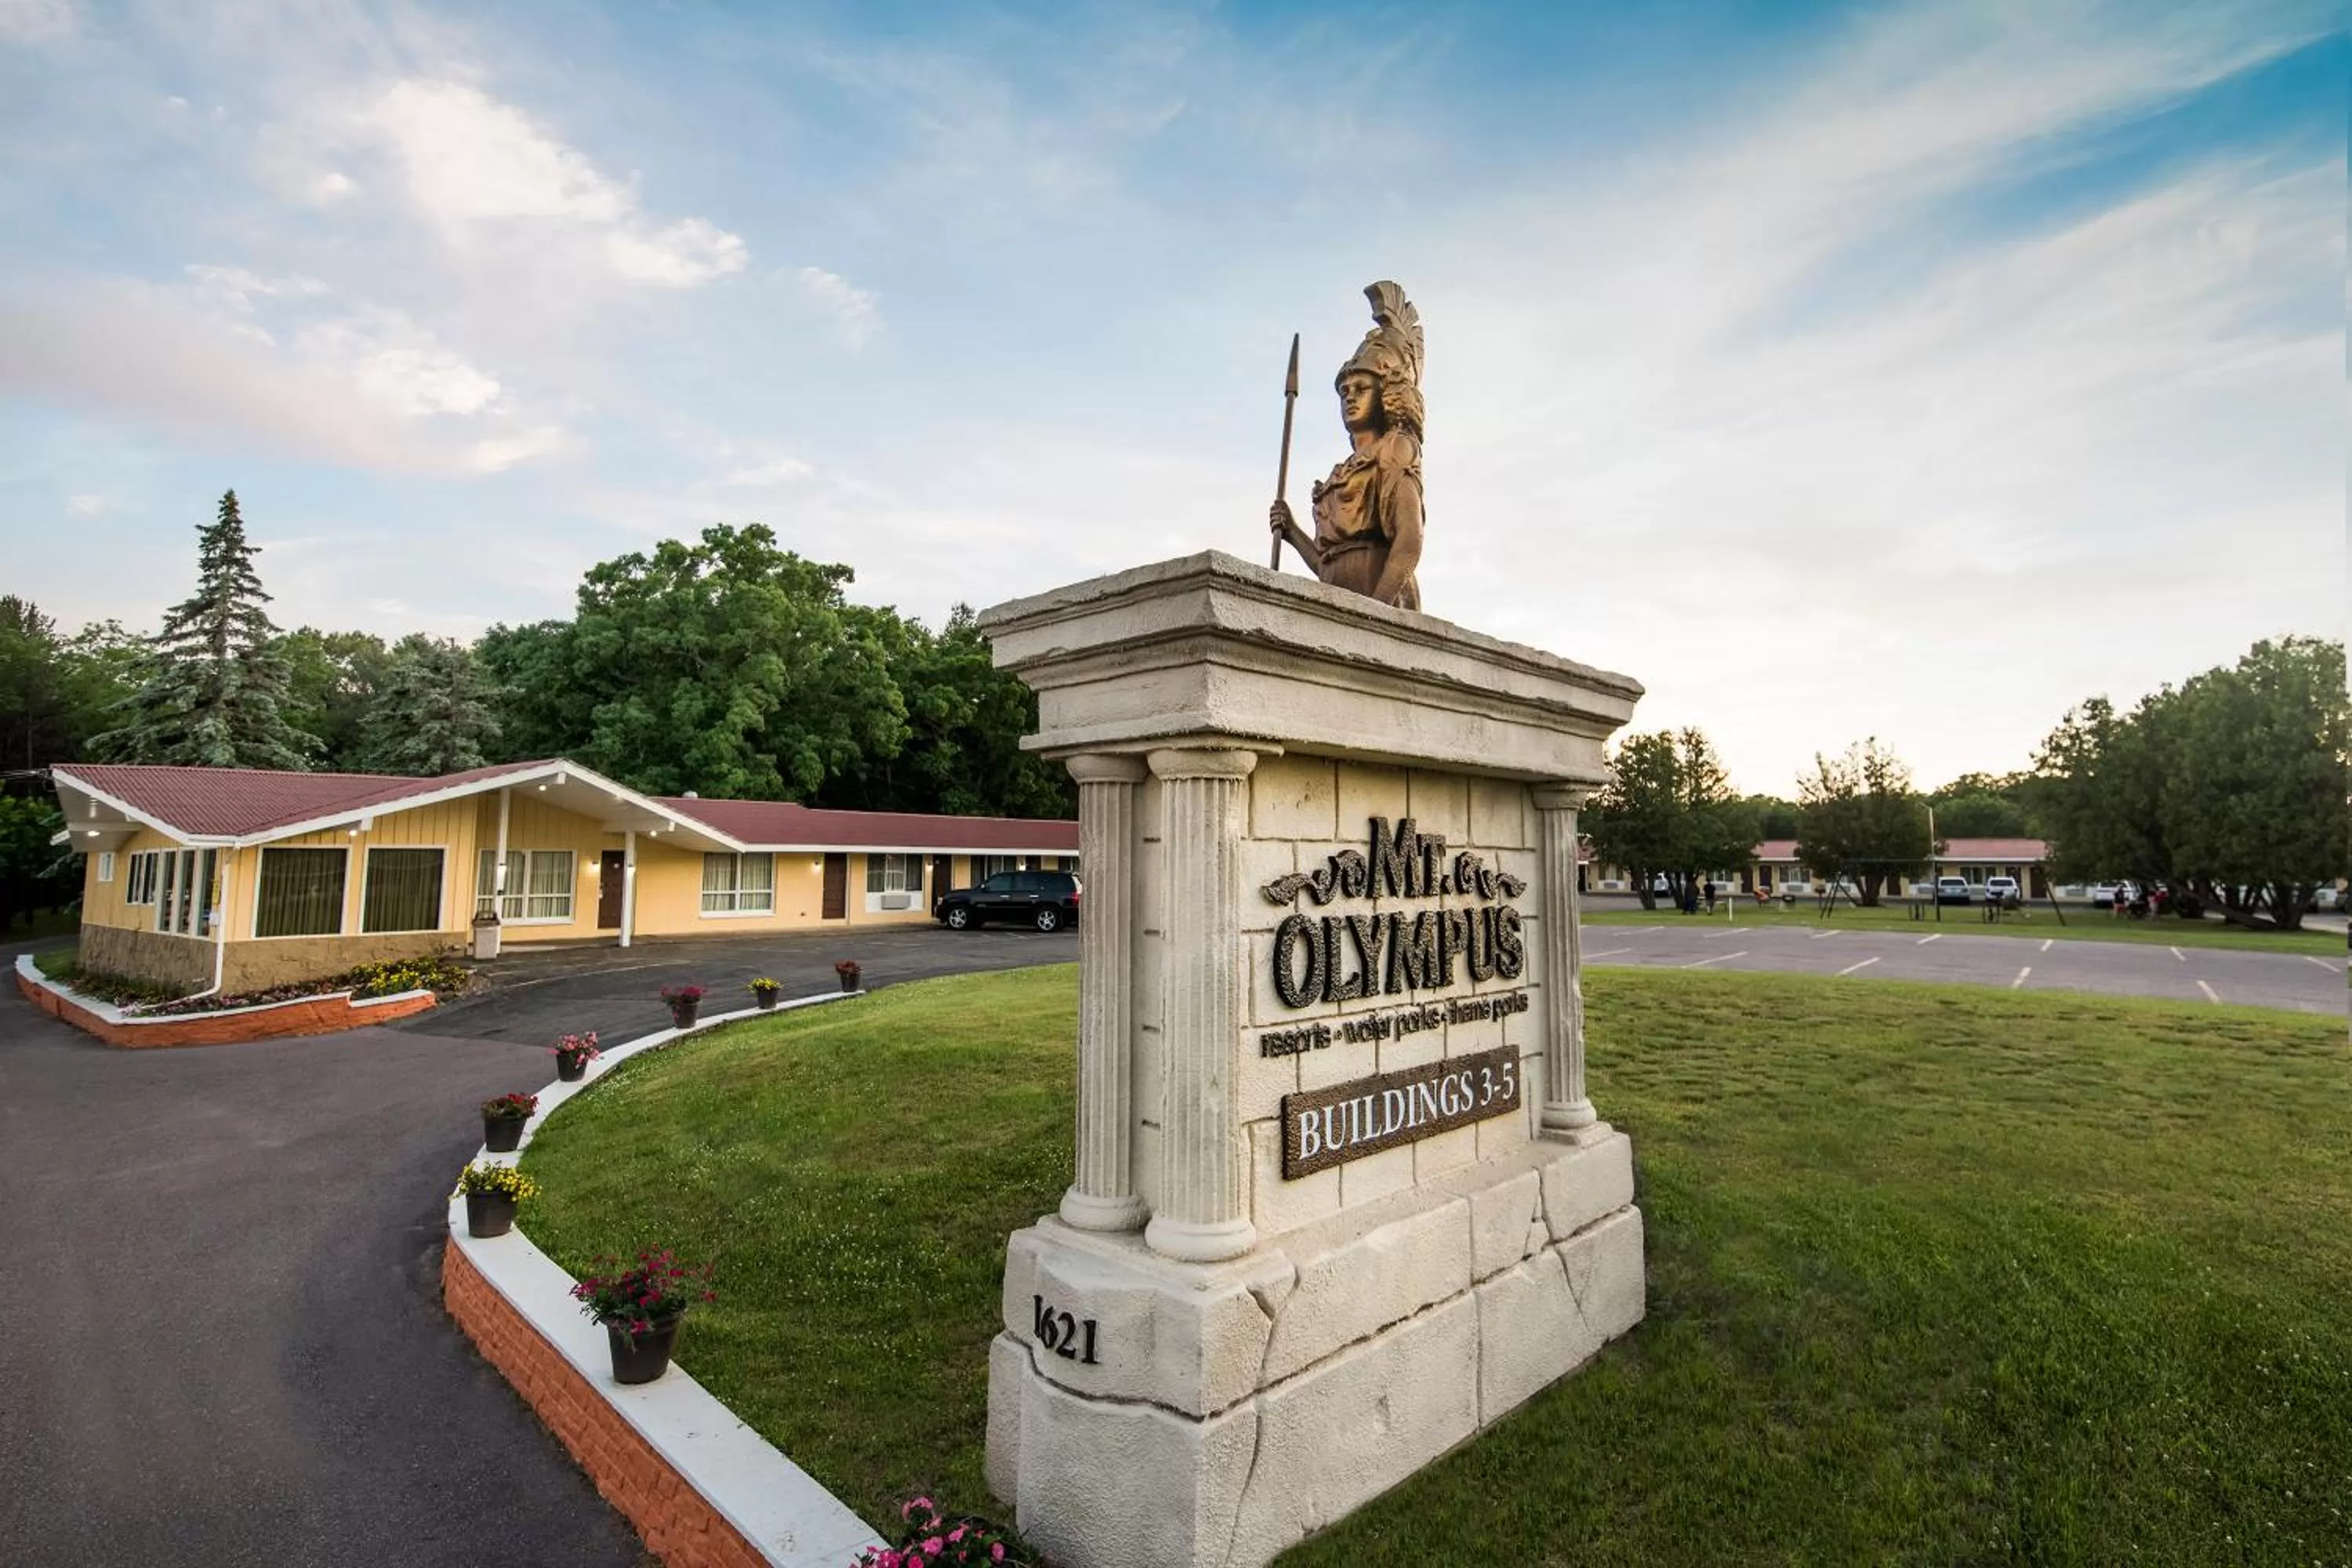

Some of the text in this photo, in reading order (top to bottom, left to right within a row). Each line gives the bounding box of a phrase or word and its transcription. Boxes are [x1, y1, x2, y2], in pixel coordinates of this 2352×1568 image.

[1273, 905, 1524, 1009] OLYMPUS
[1260, 990, 1528, 1058] resorts water parks theme parks
[1298, 1062, 1515, 1160] BUILDINGS 3-5
[1032, 1294, 1101, 1365] 1621
